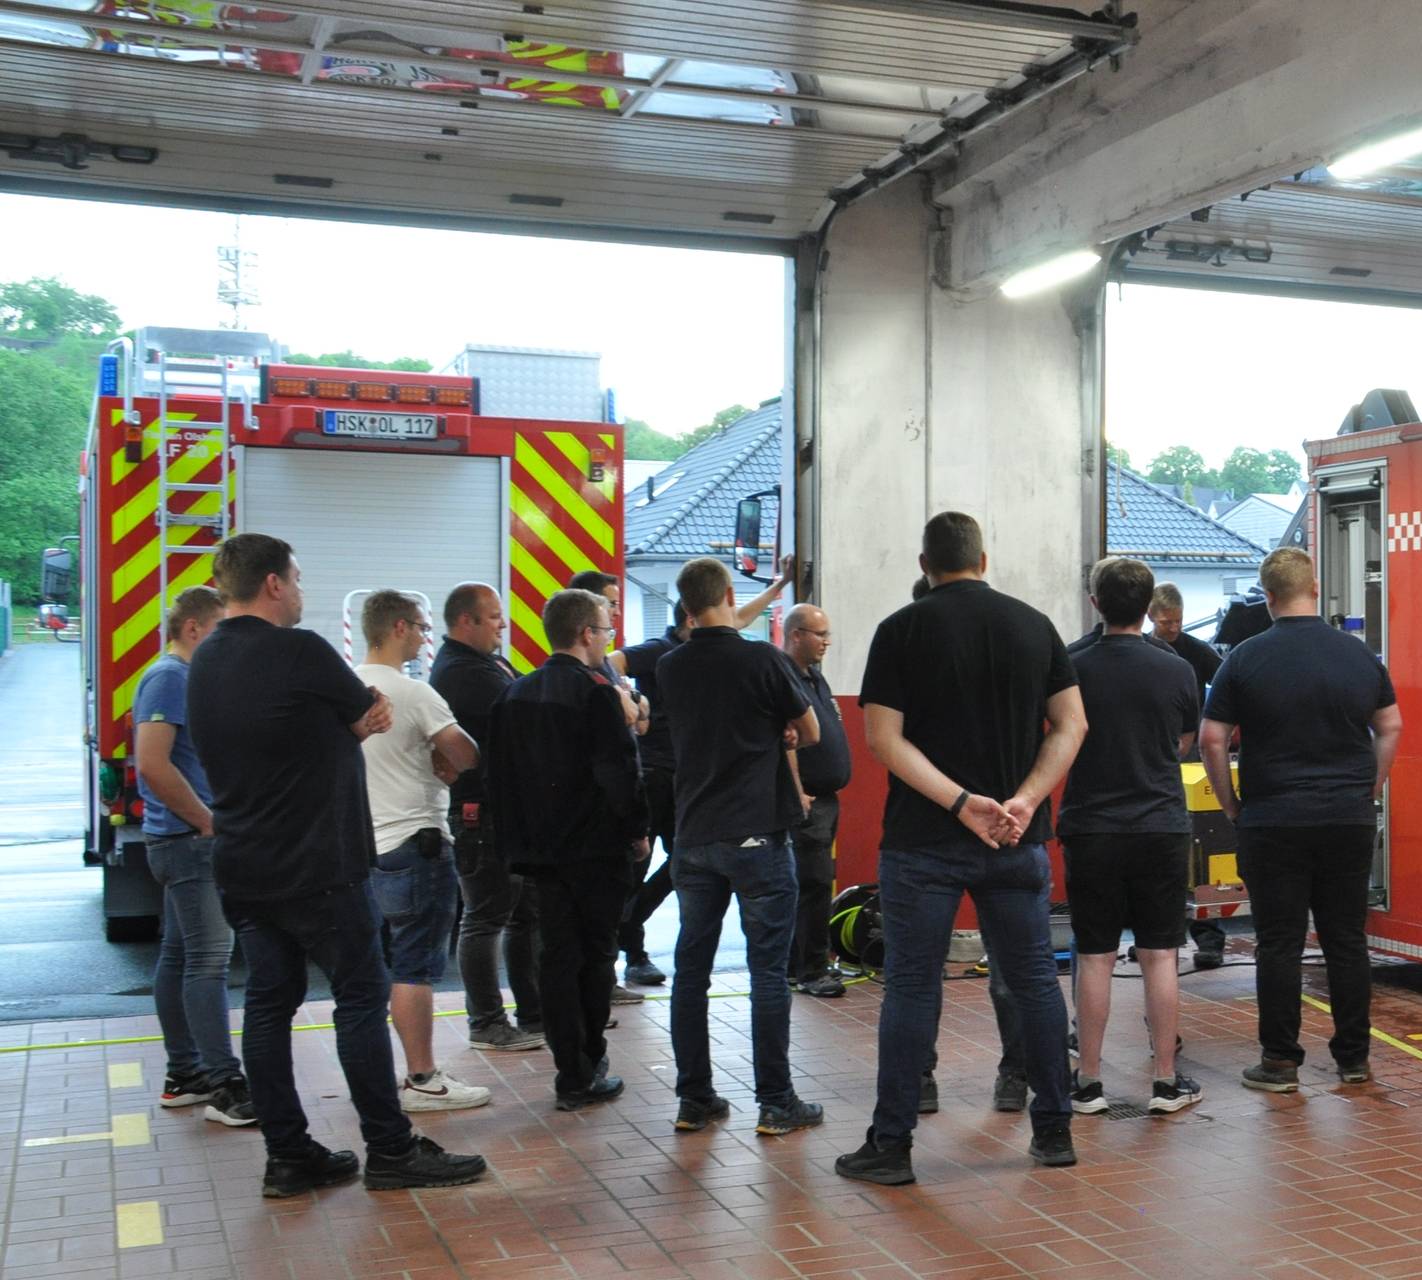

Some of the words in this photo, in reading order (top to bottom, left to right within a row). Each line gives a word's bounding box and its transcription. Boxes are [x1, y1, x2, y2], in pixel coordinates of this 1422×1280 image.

[336, 414, 368, 432] HSK
[378, 416, 399, 433] OL
[404, 417, 434, 435] 117
